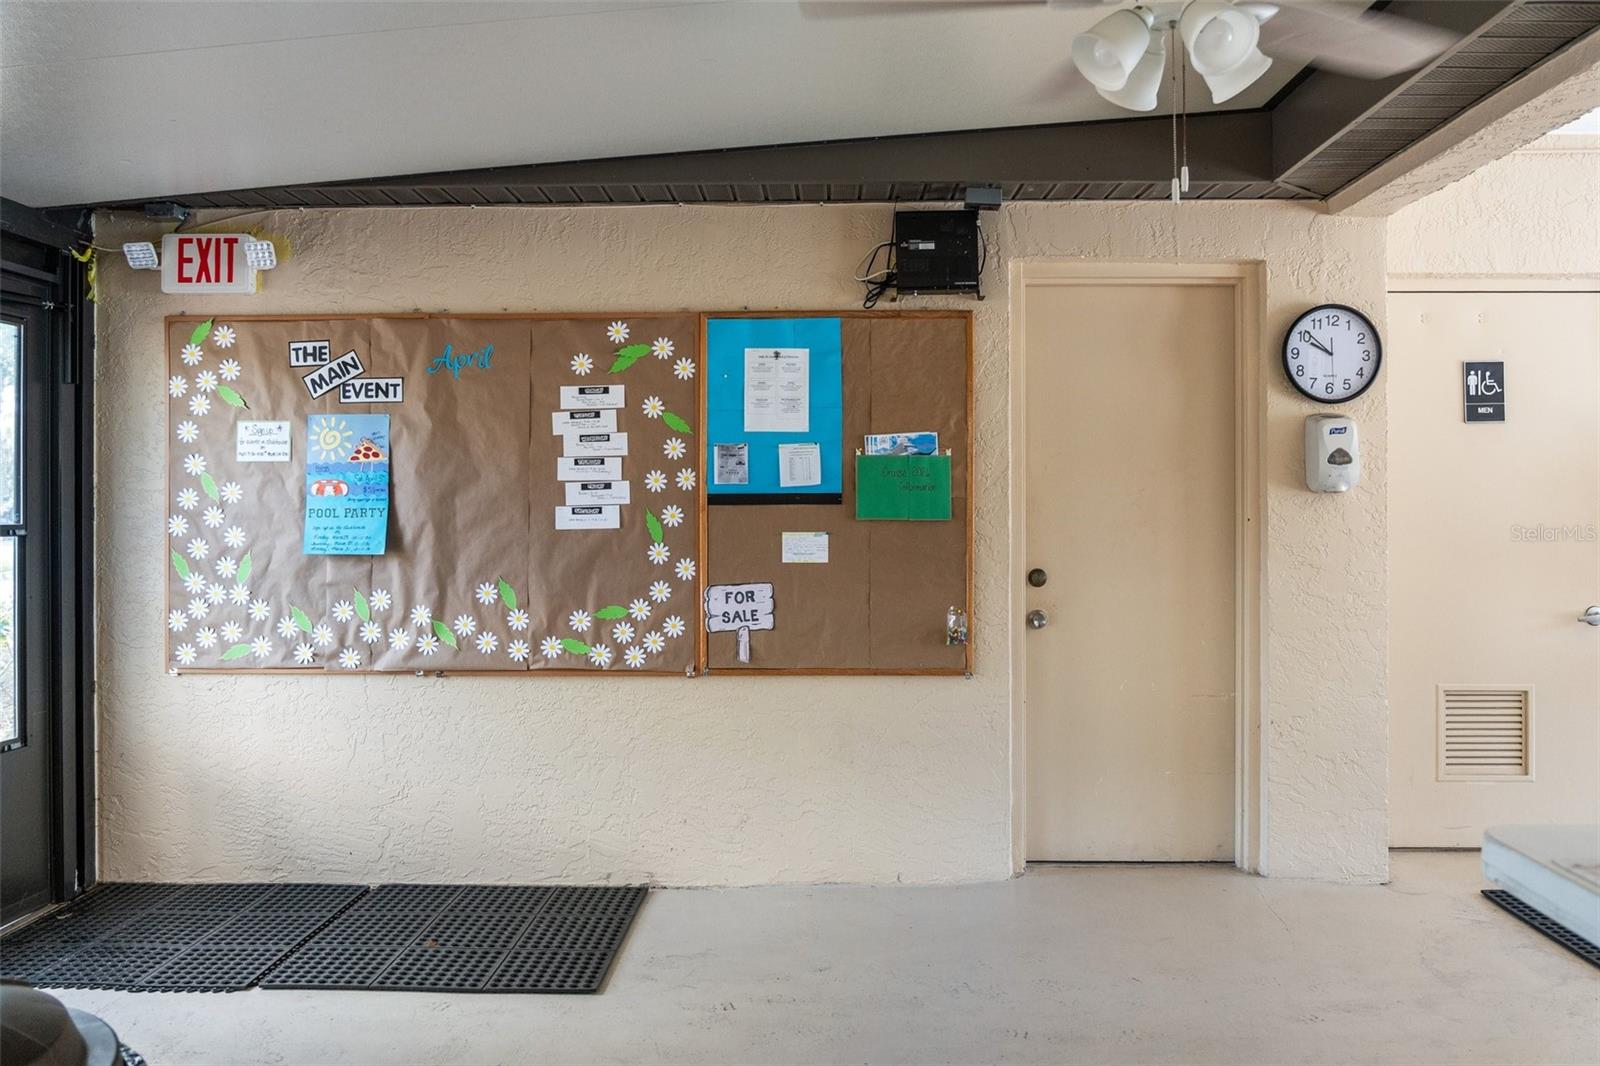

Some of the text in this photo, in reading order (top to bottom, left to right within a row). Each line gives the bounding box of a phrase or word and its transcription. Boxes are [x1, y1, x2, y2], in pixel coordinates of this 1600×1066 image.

[178, 238, 238, 283] EXIT
[1311, 318, 1322, 330] 11
[1325, 315, 1340, 327] 12
[1346, 320, 1351, 331] 1
[1297, 330, 1312, 343] 10
[1357, 332, 1366, 345] 2
[292, 346, 328, 363] THE
[1291, 347, 1300, 360] 9
[1362, 350, 1371, 362] 3
[426, 344, 494, 381] April
[310, 356, 360, 394] MAIN
[1296, 365, 1305, 377] 8
[1356, 367, 1365, 379] 4
[1309, 377, 1318, 389] 7
[1325, 382, 1334, 394] 6
[1342, 379, 1351, 390] 5
[342, 382, 401, 399] EVENT
[308, 507, 386, 518] POOL PARTY
[725, 591, 755, 604] FOR
[722, 609, 760, 624] SALE
